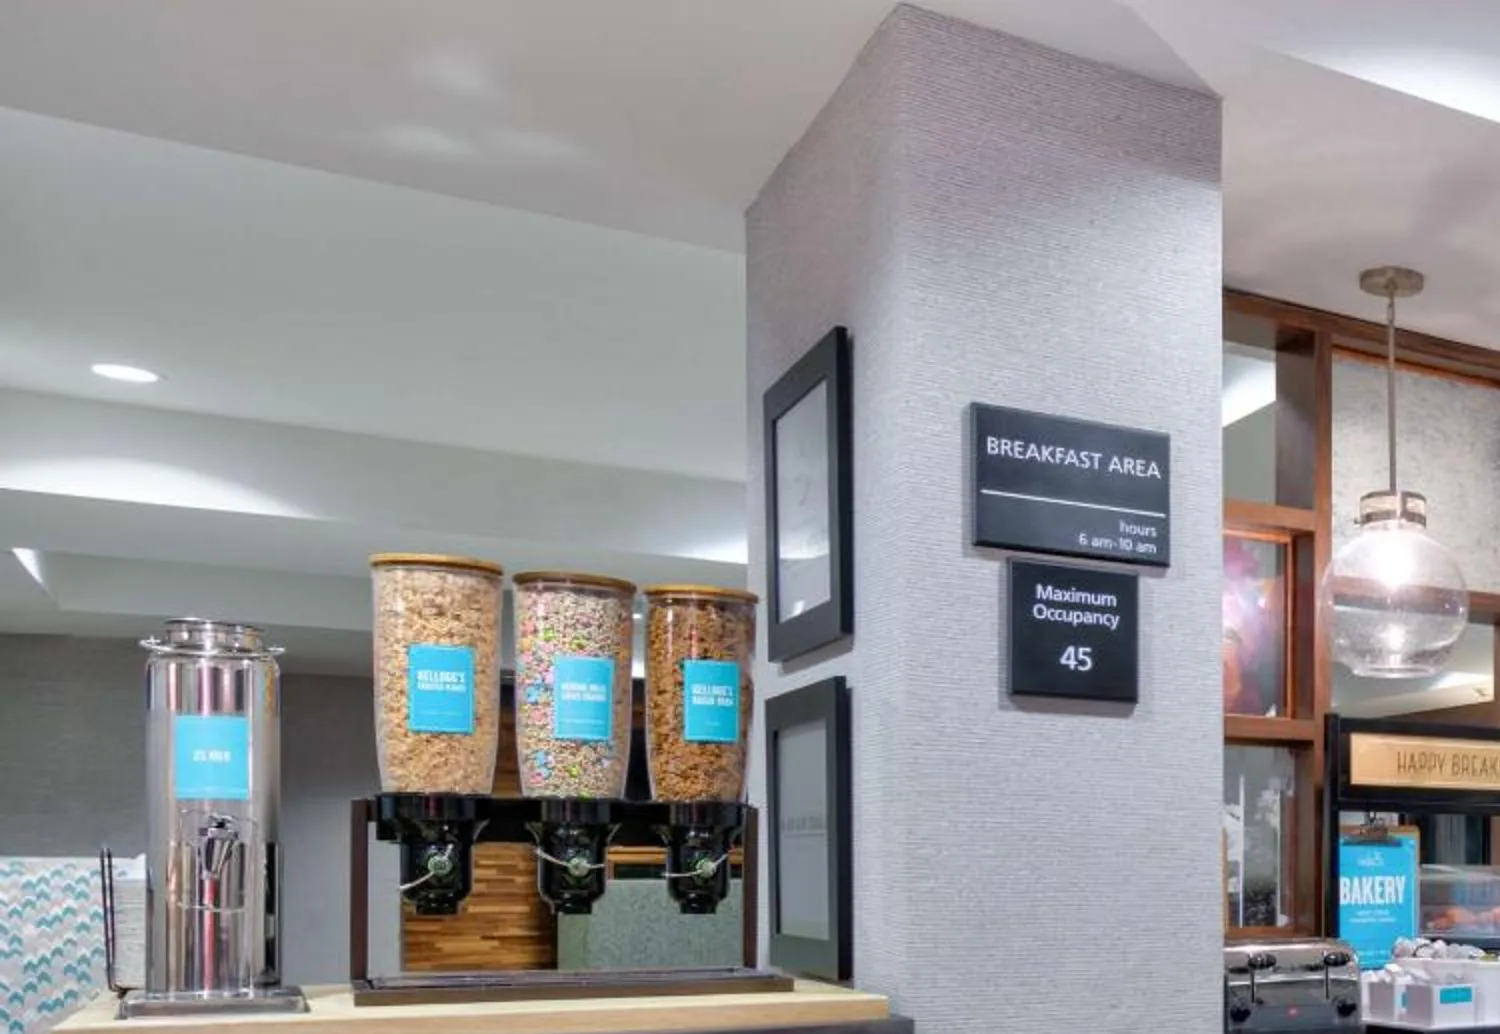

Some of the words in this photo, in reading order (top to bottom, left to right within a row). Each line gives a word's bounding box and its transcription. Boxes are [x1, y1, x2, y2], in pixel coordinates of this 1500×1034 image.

[987, 436, 1102, 470] BREAKFAST
[1108, 456, 1161, 479] AREA
[1079, 533, 1088, 545] 6
[1119, 520, 1157, 537] hours
[1035, 583, 1117, 607] Maximum
[1033, 603, 1120, 631] Occupancy
[1059, 645, 1093, 672] 45
[1397, 751, 1447, 775] HAPPY
[1339, 875, 1405, 905] BAKERY
